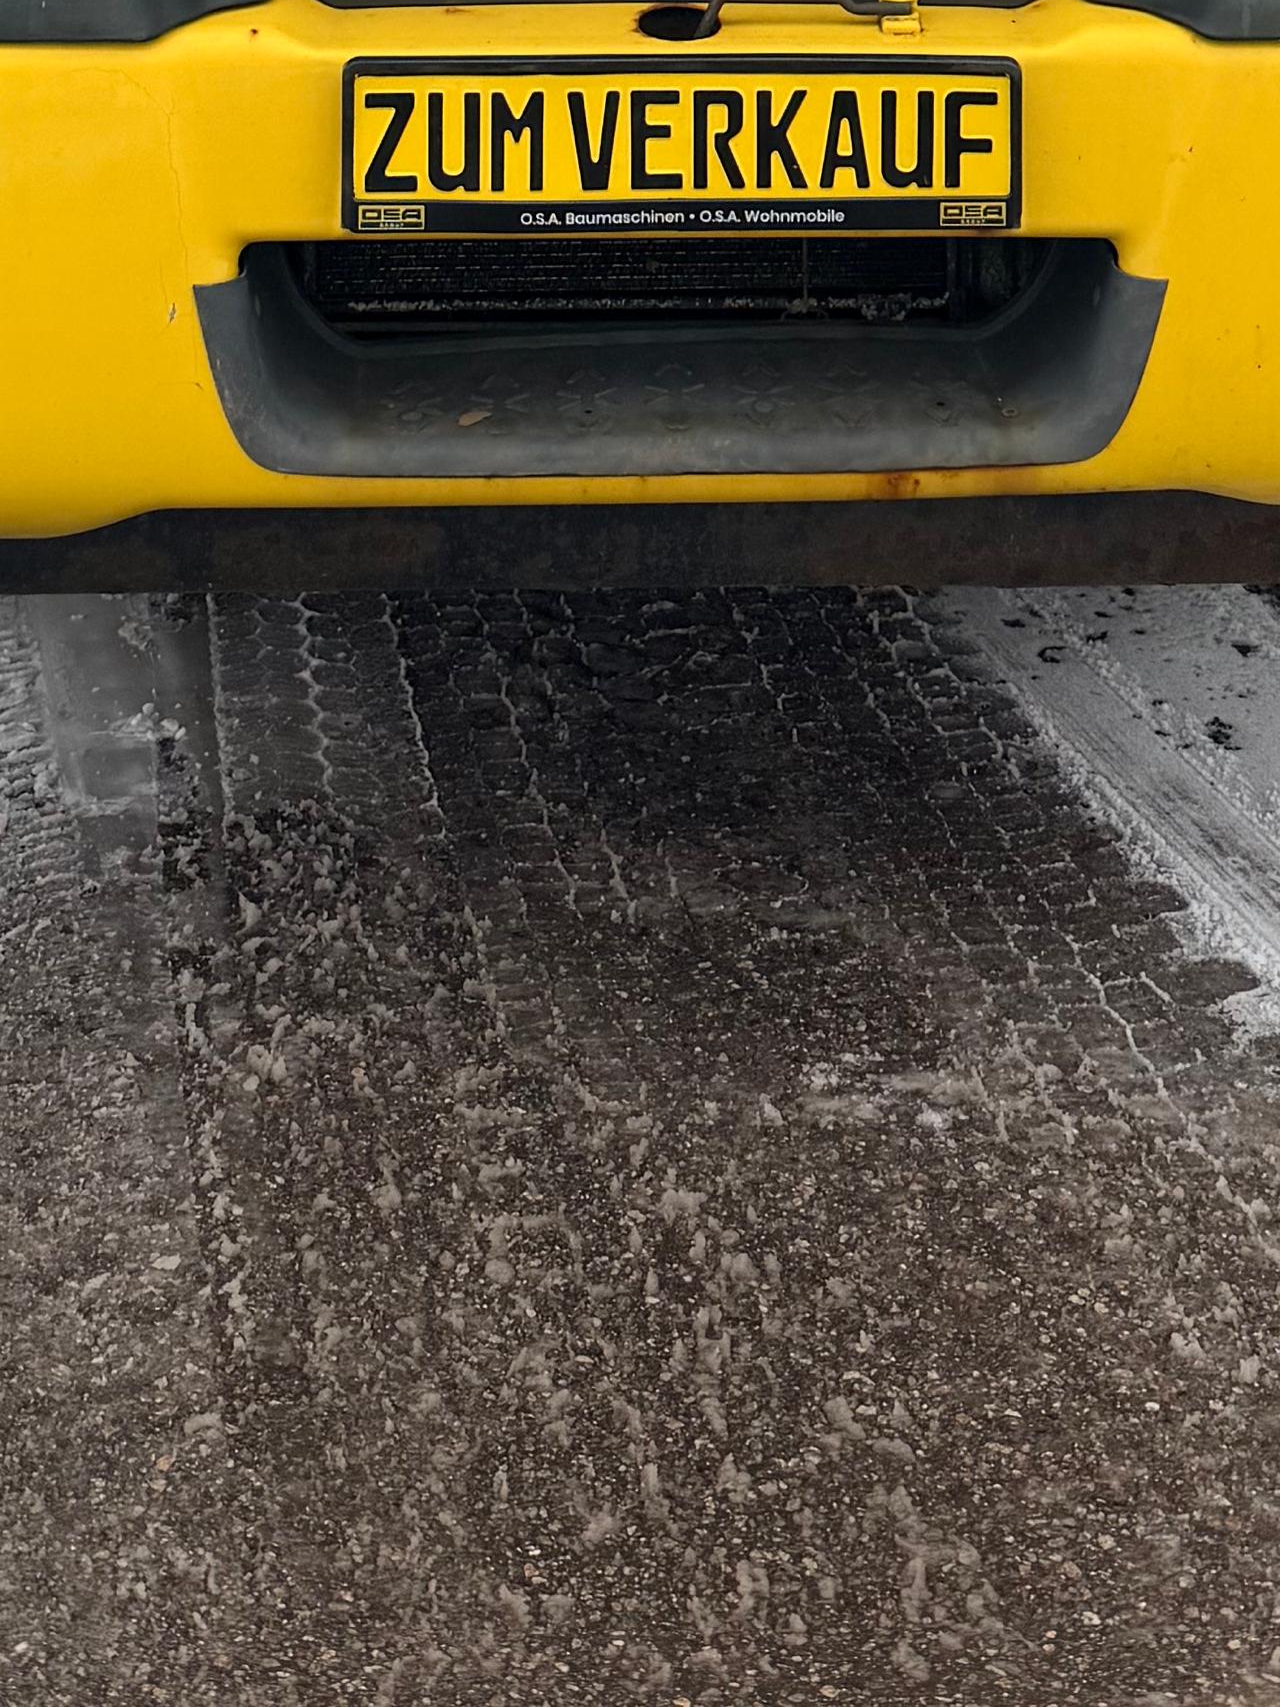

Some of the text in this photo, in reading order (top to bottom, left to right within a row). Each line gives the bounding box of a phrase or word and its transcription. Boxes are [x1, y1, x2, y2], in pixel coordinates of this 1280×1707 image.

[364, 89, 999, 193] ZUM VERKAUF
[520, 208, 845, 226] O.S.A. Baumaschinen O.S.A. Wohnmobile
